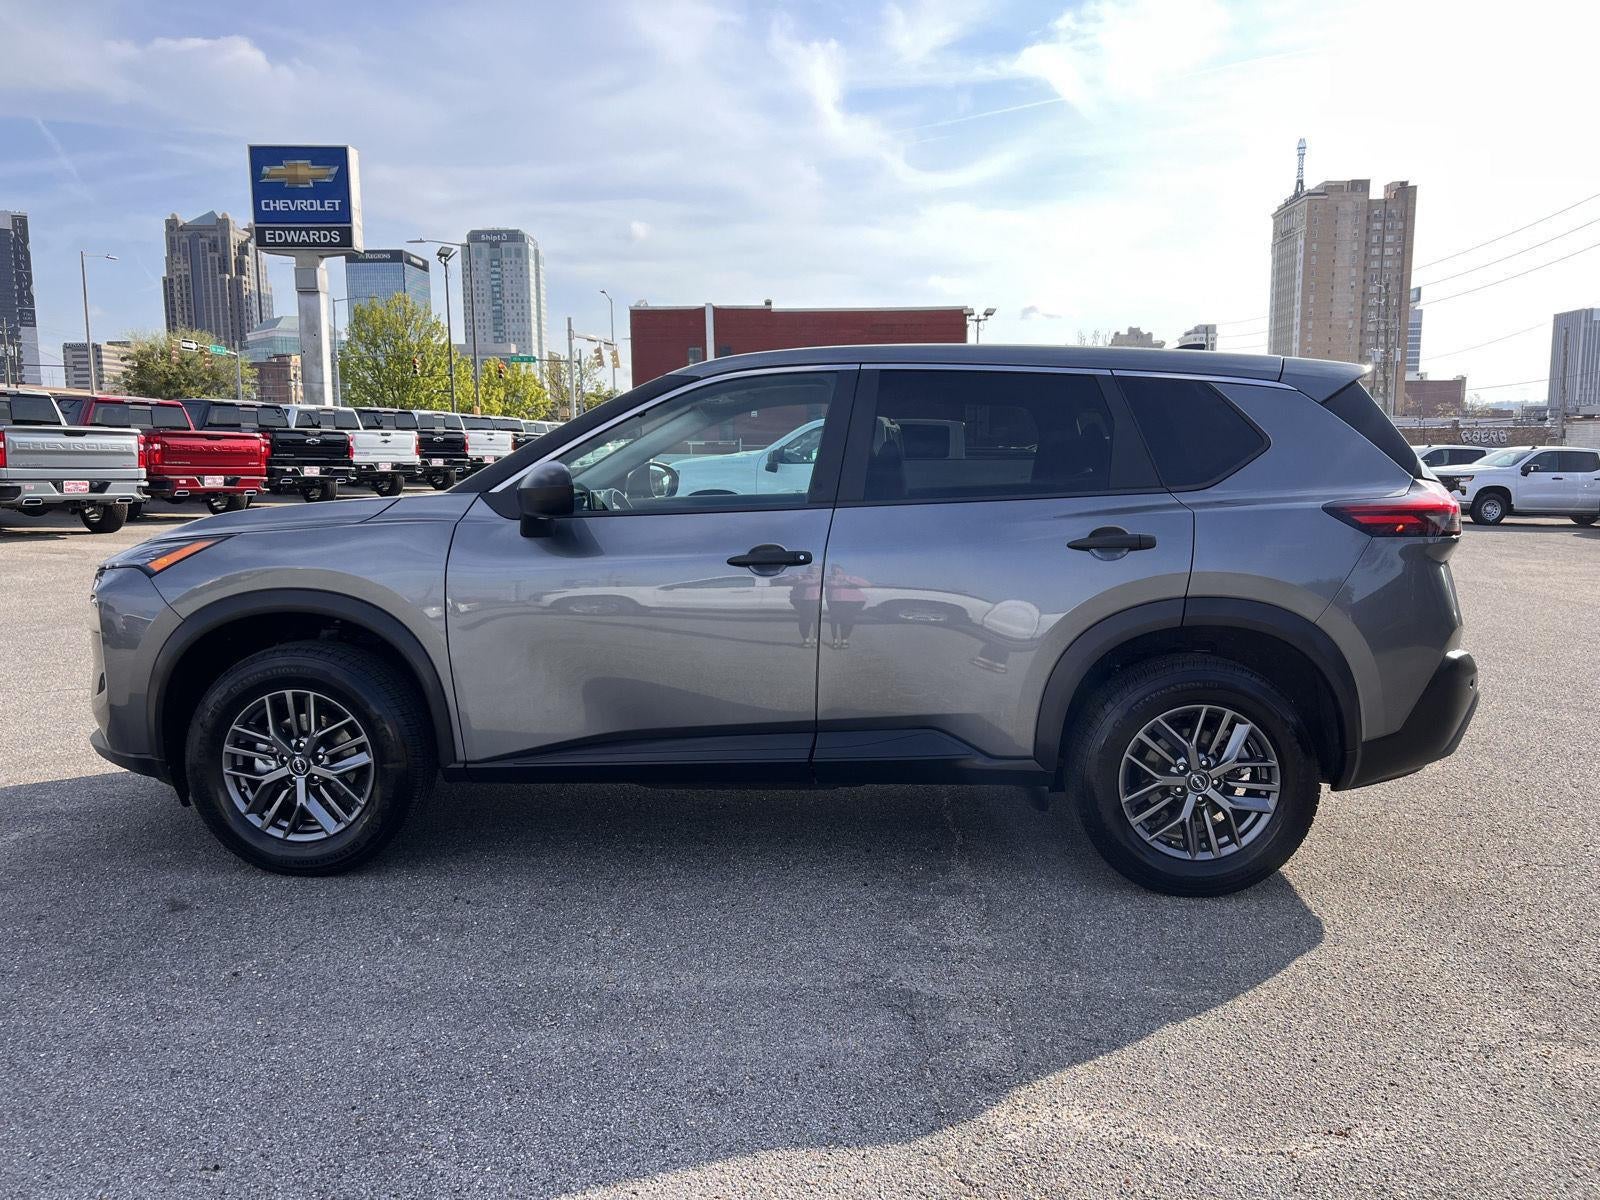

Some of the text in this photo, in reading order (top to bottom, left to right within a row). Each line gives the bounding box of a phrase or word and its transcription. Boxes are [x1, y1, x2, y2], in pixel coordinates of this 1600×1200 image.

[261, 199, 341, 211] CHEVROLET
[265, 230, 341, 243] EDWARDS
[481, 233, 501, 242] Shipt
[16, 440, 132, 452] CHEVROLET
